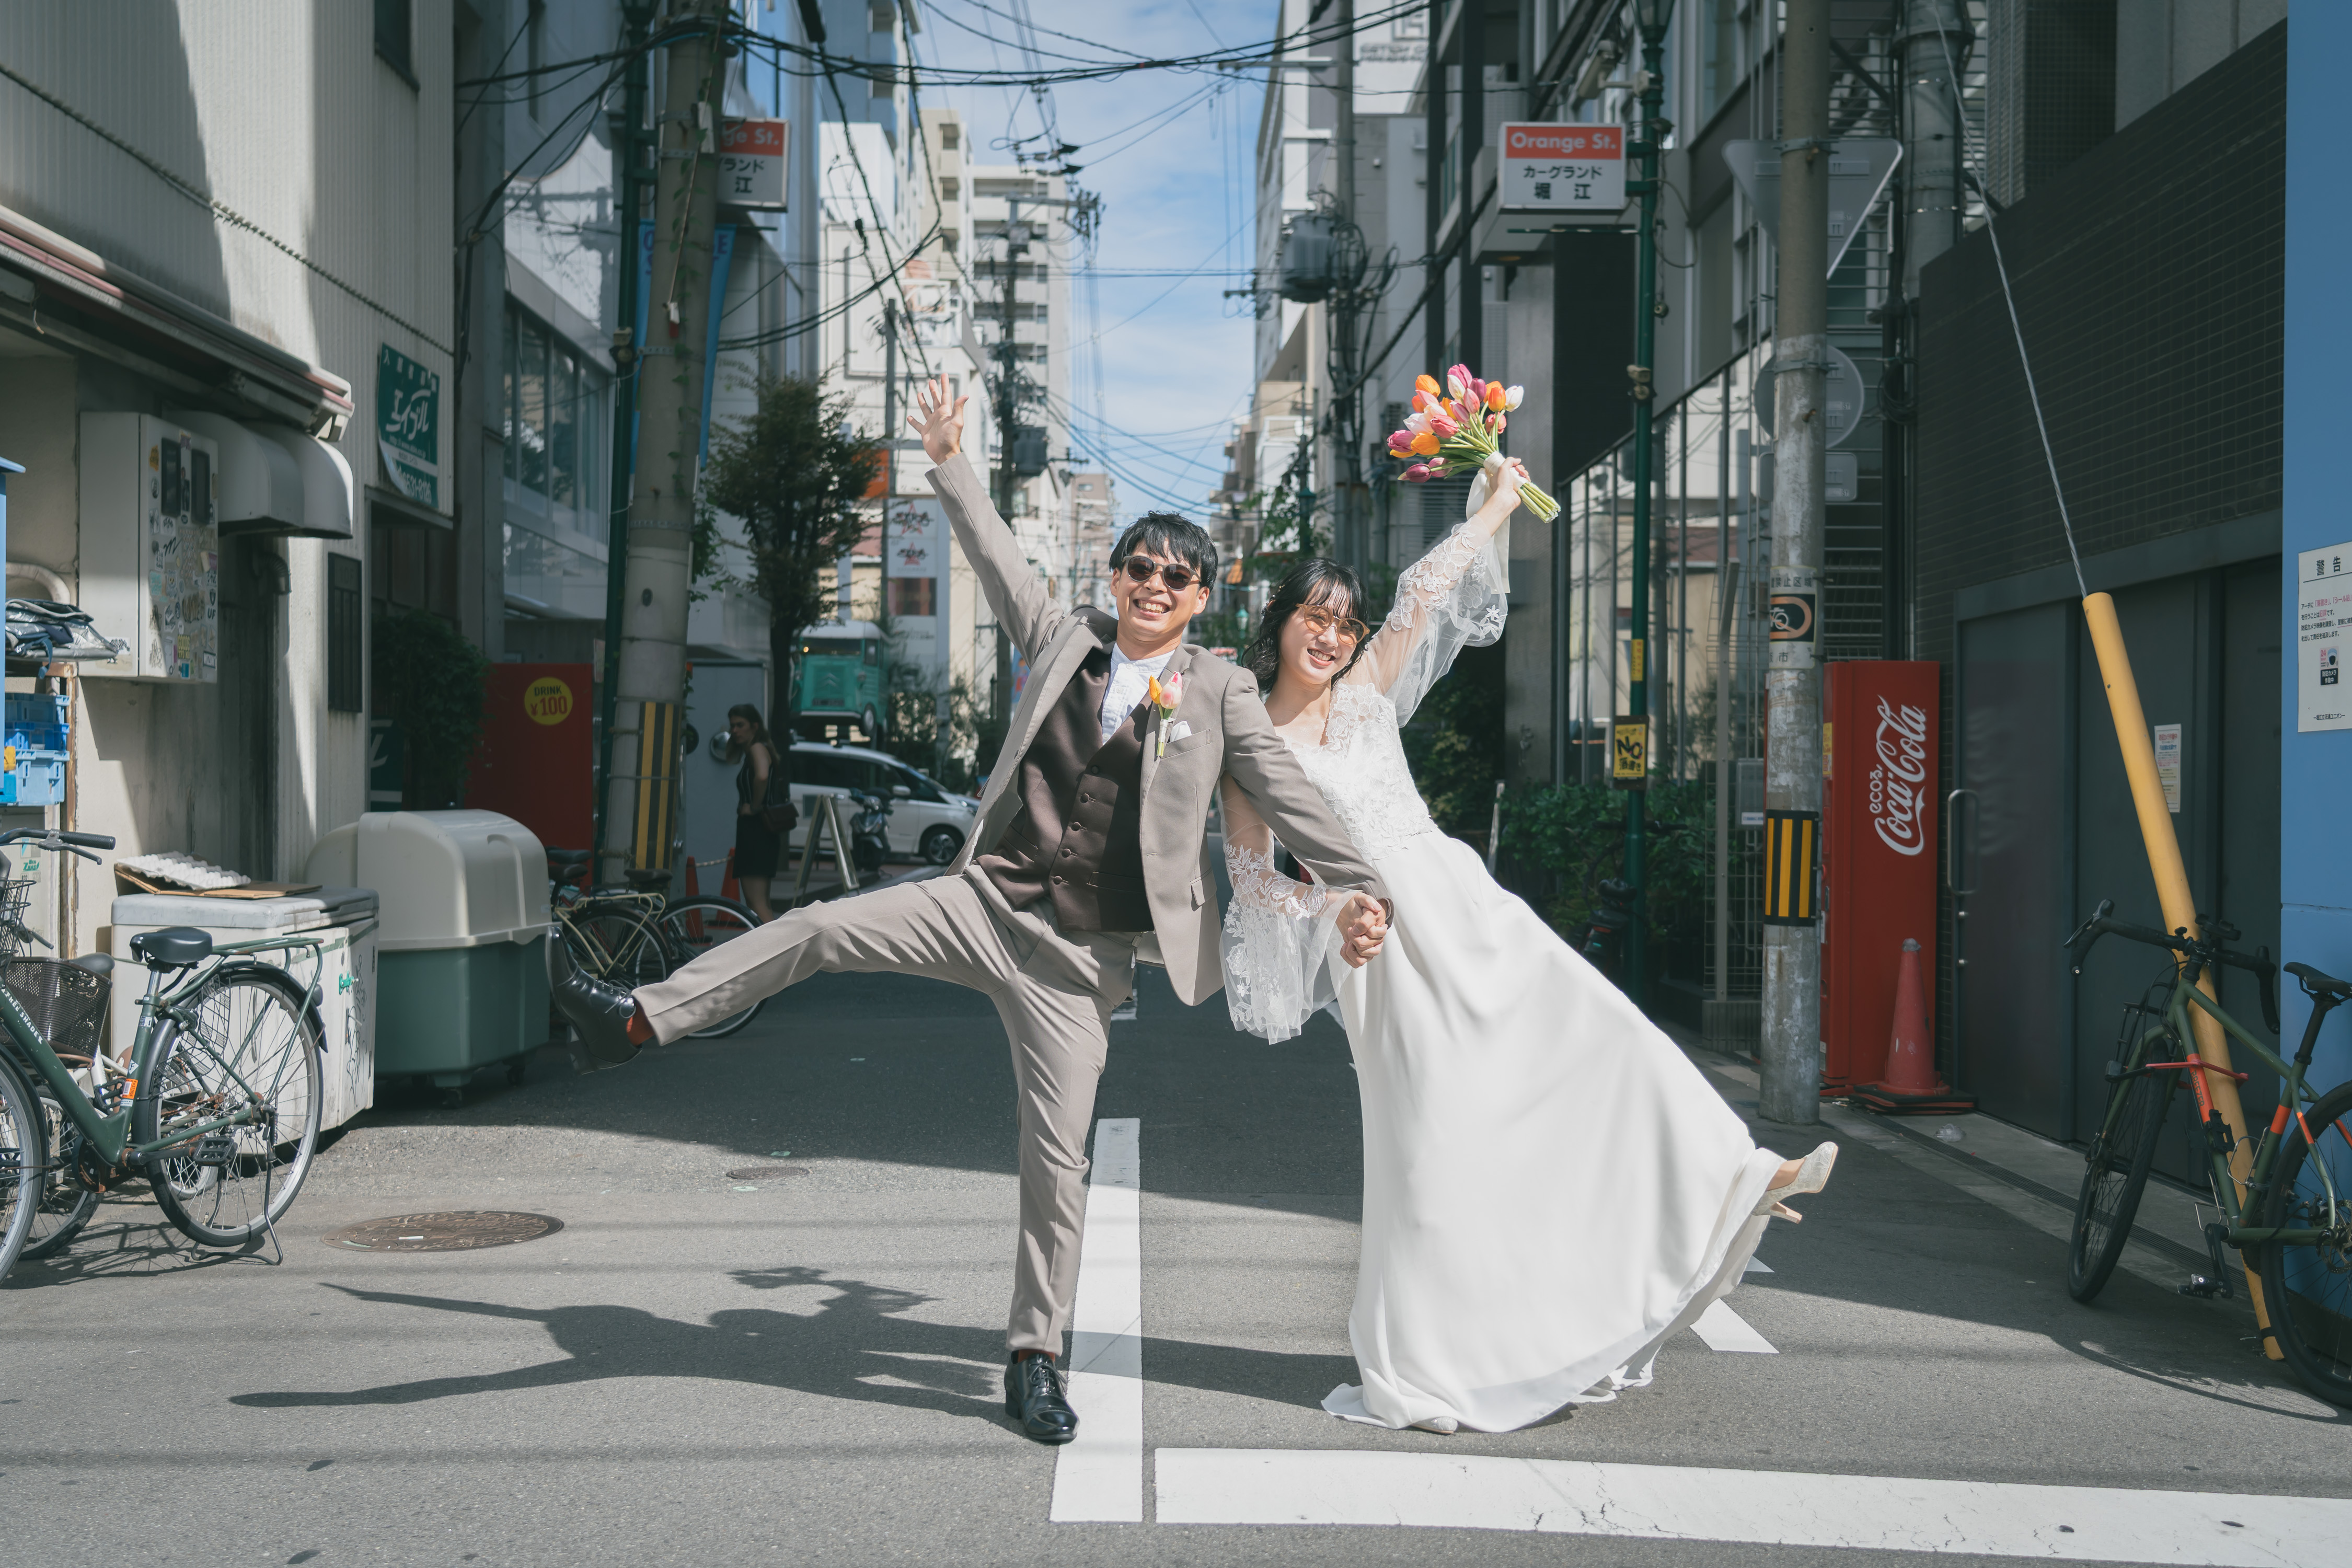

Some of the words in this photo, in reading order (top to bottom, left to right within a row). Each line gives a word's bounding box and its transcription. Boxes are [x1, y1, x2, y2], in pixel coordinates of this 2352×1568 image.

[754, 128, 779, 145] St.
[1511, 132, 1586, 154] Orange
[1592, 133, 1617, 150] St.
[720, 158, 765, 174] ランド
[1523, 165, 1602, 180] カーグランド
[386, 388, 431, 441] エイブル
[2316, 556, 2341, 576] 警告
[534, 685, 562, 697] DRINK
[530, 696, 569, 716] ¥100
[1616, 735, 1644, 760] NO
[1874, 694, 1927, 856] Coca-Cola
[20, 1011, 43, 1045] SHADER
